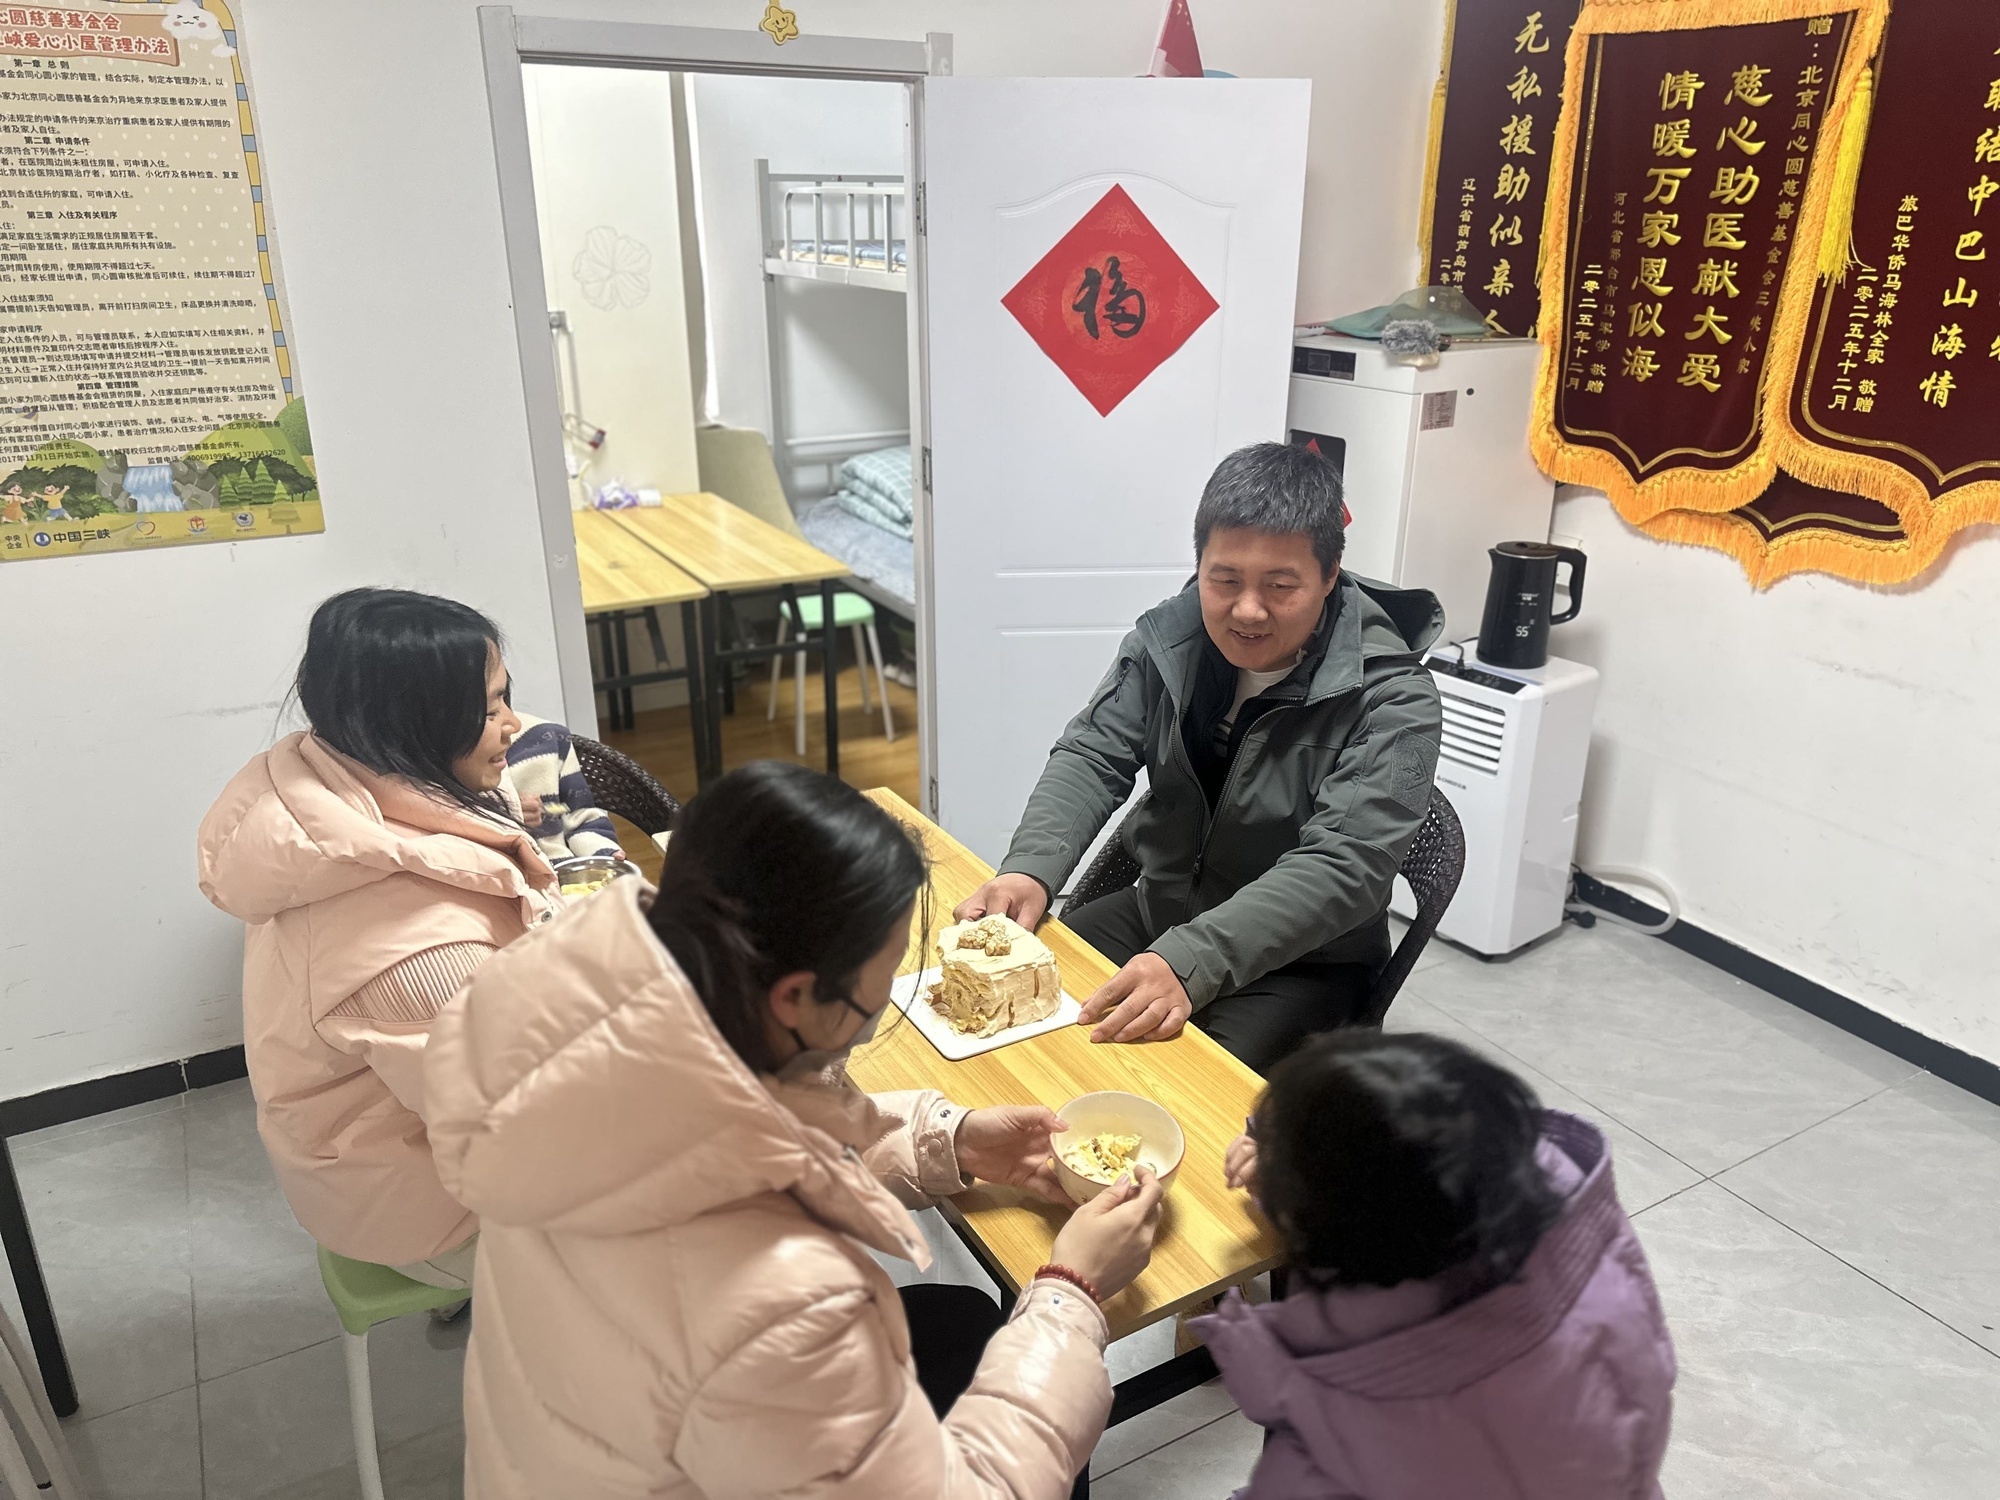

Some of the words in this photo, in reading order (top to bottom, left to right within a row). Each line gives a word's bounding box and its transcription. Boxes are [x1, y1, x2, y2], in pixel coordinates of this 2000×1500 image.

[0, 31, 169, 54] 峡爱心小屋管理办法
[14, 59, 41, 68] 第一章
[0, 92, 227, 107] 家为北京同心圆慈善基金会为异地来京求医患者及家人提供
[0, 125, 60, 134] 者及家人自住。
[24, 136, 51, 145] 第二章
[55, 137, 90, 146] 申请条件
[27, 211, 53, 219] 第三章
[58, 211, 117, 220] 入住及有关程序
[1621, 70, 1704, 382] 情暖万家恩似海
[1677, 64, 1772, 392] 慈心助医献大爱
[1920, 47, 2000, 408] 结中巴山海情
[0, 241, 176, 251] 定一间卧室居住，居住家庭共用所有共有设施。
[0, 271, 255, 282] 后，经家长提出申请，同心圆审核批准后可续住，续住期不得超过7
[1864, 195, 1919, 364] 旅巴华侨马海林全家
[1072, 256, 1146, 340] 福
[1566, 264, 1604, 390] 二零二五年十二月
[1828, 268, 1878, 410] 二零二五年十二月
[77, 382, 102, 391] 第四章
[105, 381, 139, 390] 管理措施
[1853, 379, 1877, 413] 敬赠
[53, 528, 111, 543] 中国三峡
